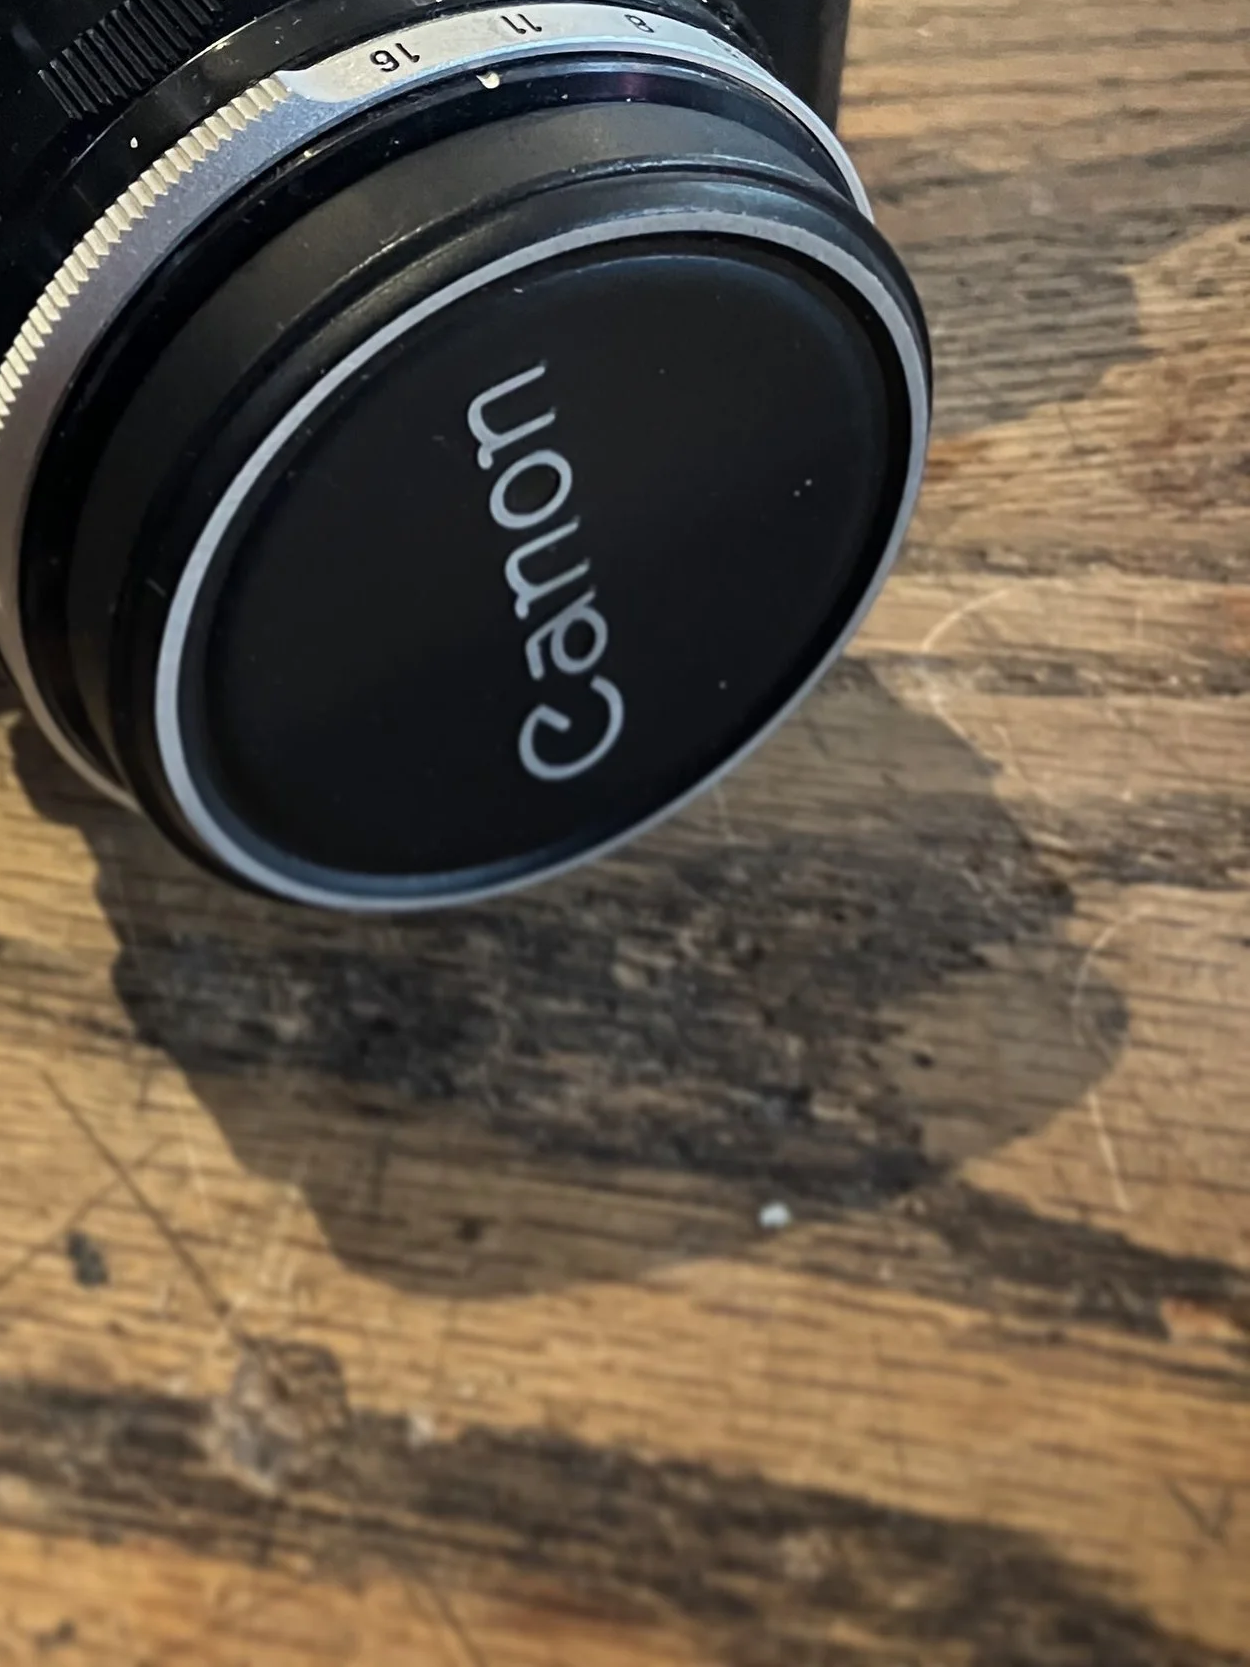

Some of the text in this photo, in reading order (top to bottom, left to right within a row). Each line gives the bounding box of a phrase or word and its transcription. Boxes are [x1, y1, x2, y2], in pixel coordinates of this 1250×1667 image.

[500, 13, 543, 35] 11
[369, 42, 421, 73] 16
[467, 361, 625, 781] Canon
